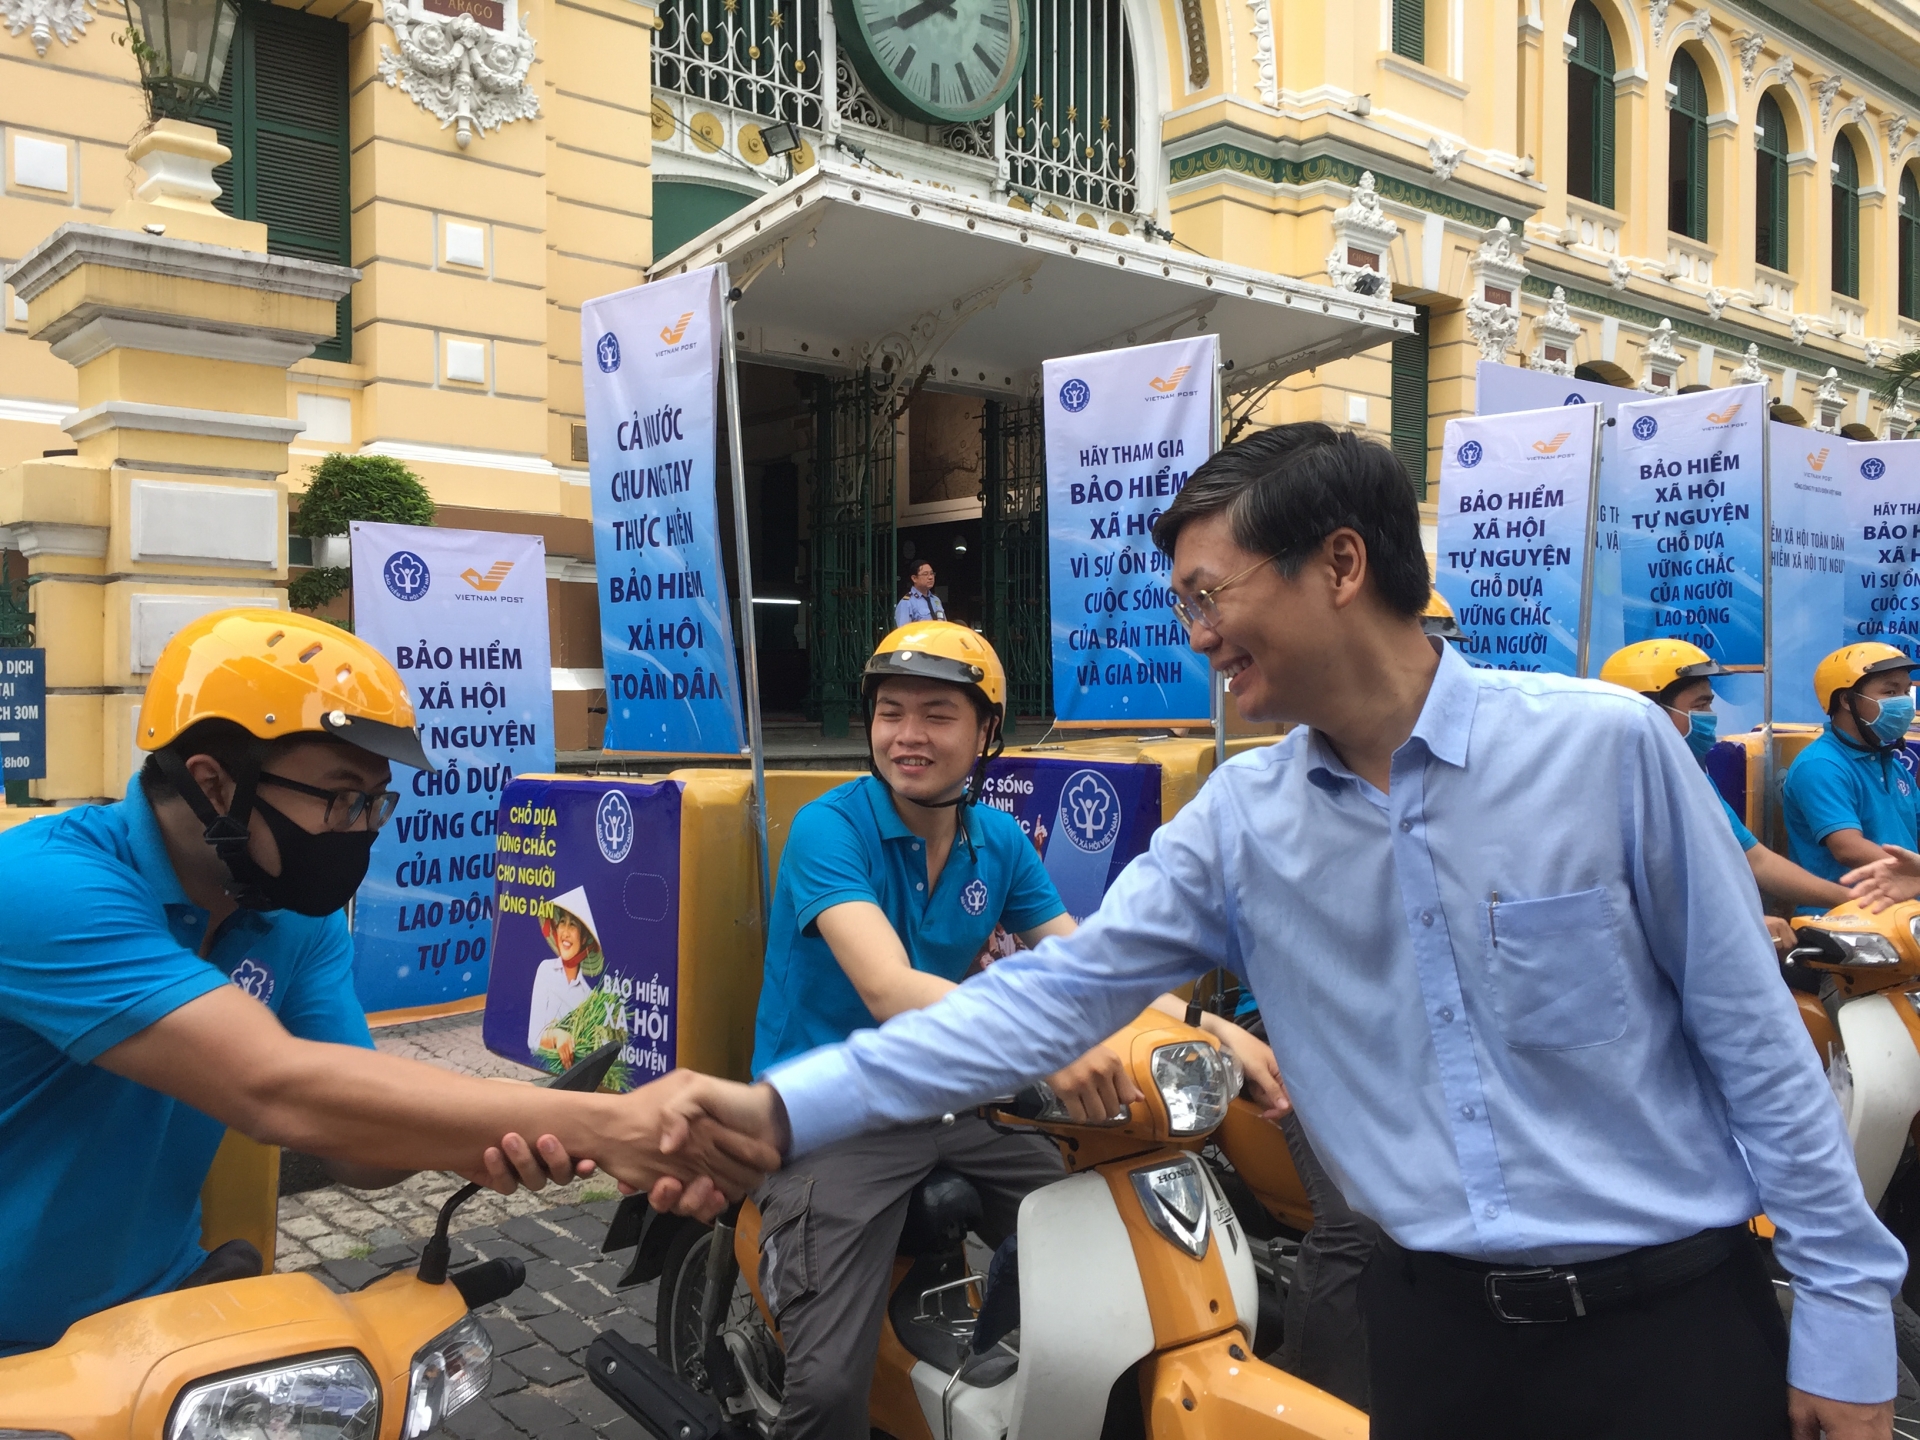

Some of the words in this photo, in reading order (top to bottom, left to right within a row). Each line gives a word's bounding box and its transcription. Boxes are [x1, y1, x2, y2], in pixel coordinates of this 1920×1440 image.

[655, 346, 680, 358] VIETNAM
[681, 342, 697, 351] POST
[1144, 393, 1175, 402] VIETNAM
[1177, 390, 1198, 398] POST
[617, 410, 643, 451] CẢ
[644, 404, 683, 448] NƯỚC
[1702, 424, 1729, 432] VIETNAM
[1079, 444, 1109, 468] HÃY
[1112, 442, 1153, 465] THAM
[1157, 439, 1185, 459] GIA
[1640, 458, 1682, 480] BẢO
[1687, 451, 1740, 475] HIỂM
[611, 467, 667, 502] CHUNG
[667, 459, 693, 496] TAY
[1070, 474, 1123, 505] BẢO
[1128, 465, 1188, 499] HIỂM
[1655, 483, 1682, 503] XÃ
[1688, 479, 1725, 502] HỘI
[1459, 488, 1503, 513] BẢO
[1508, 484, 1564, 510] HIỂM
[1873, 502, 1898, 516] HÃY
[1090, 511, 1121, 540] XÃ
[1472, 517, 1500, 540] XÃ
[1506, 516, 1546, 543] HỘI
[1632, 510, 1660, 533] TỰ
[1665, 502, 1749, 527] NGUYỆN
[1863, 521, 1907, 540] BẢO
[612, 514, 660, 557] THỰC
[666, 507, 694, 553] HIỆN
[1657, 530, 1690, 554] CHỖ
[1694, 531, 1725, 554] DỰA
[1784, 527, 1794, 545] XÃ
[1796, 528, 1809, 549] HỘI
[1811, 531, 1829, 550] TOÀN
[1831, 532, 1845, 551] DÂN
[1070, 553, 1089, 579] VÌ
[1094, 551, 1115, 582] SỰ
[1118, 545, 1146, 575] ỔN
[1448, 548, 1477, 573] TỰ
[1480, 544, 1571, 571] NGUYỆN
[1648, 558, 1692, 579] VỮNG
[1696, 552, 1735, 575] CHẮC
[1792, 551, 1802, 569] XÃ
[1804, 553, 1816, 574] HỘI
[1818, 555, 1827, 575] TỰ
[1829, 558, 1845, 574] NGU
[1878, 545, 1905, 564] XÃ
[610, 567, 652, 603] BẢO
[657, 561, 705, 600] HIỂM
[1470, 572, 1501, 598] CHỖ
[1507, 576, 1543, 602] DỰA
[1650, 582, 1680, 603] CỦA
[1684, 580, 1733, 601] NGƯỜI
[1861, 571, 1876, 588] VÌ
[1880, 572, 1900, 591] SỰ
[455, 594, 497, 602] VIETNAM
[501, 596, 524, 604] POST
[1084, 586, 1129, 619] CUỘC
[1132, 581, 1177, 611] SỐNG
[1871, 594, 1908, 615] CUỘC
[1459, 604, 1506, 626] VỮNG
[1510, 601, 1552, 626] CHẮC
[1655, 608, 1682, 627] LAO
[1685, 606, 1729, 629] ĐỘNG
[1857, 618, 1884, 636] CỦA
[1888, 617, 1919, 635] BẢN
[628, 617, 655, 651] XÃ
[659, 616, 704, 657] HỘI
[1068, 622, 1101, 651] CỦA
[1106, 620, 1141, 649] BẢN
[1496, 632, 1548, 655] NGƯỜI
[1694, 633, 1715, 650] DO
[396, 639, 453, 670] BẢO
[460, 639, 523, 670] HIỂM
[6, 660, 34, 678] DỊCH
[1076, 660, 1101, 687] VÀ
[1105, 663, 1133, 686] GIA
[1136, 657, 1182, 685] ĐÌNH
[419, 681, 454, 709] XÃ
[461, 681, 506, 715] HỘI
[611, 668, 667, 700] TOÀN
[14, 705, 39, 720] 30M
[431, 720, 536, 754] NGUYỆN
[2, 756, 30, 769] 8h00
[412, 758, 460, 797] CHỖ
[467, 762, 513, 800] DỰA
[997, 773, 1034, 795] SỐNG
[395, 809, 464, 844] VỮNG
[470, 810, 498, 837] CH
[510, 800, 532, 826] CHỖ
[534, 805, 557, 830] DỰA
[1110, 812, 1118, 832] NAM
[496, 831, 521, 854] VỮNG
[522, 831, 556, 857] CHẮC
[395, 851, 442, 888] CỦA
[497, 864, 516, 884] CHO
[518, 866, 555, 888] NGƯỜI
[398, 901, 443, 933] LAO
[448, 891, 493, 930] ĐỘN
[530, 894, 554, 919] DÂN
[417, 939, 451, 976] TỰ
[454, 936, 486, 965] DO
[603, 969, 632, 999] BẢO
[636, 972, 669, 1007] HIỂM
[603, 998, 628, 1032] XÃ
[634, 1004, 668, 1047] HỘI
[617, 1044, 667, 1076] NGUYỆN
[1157, 1168, 1197, 1184] HONDA
